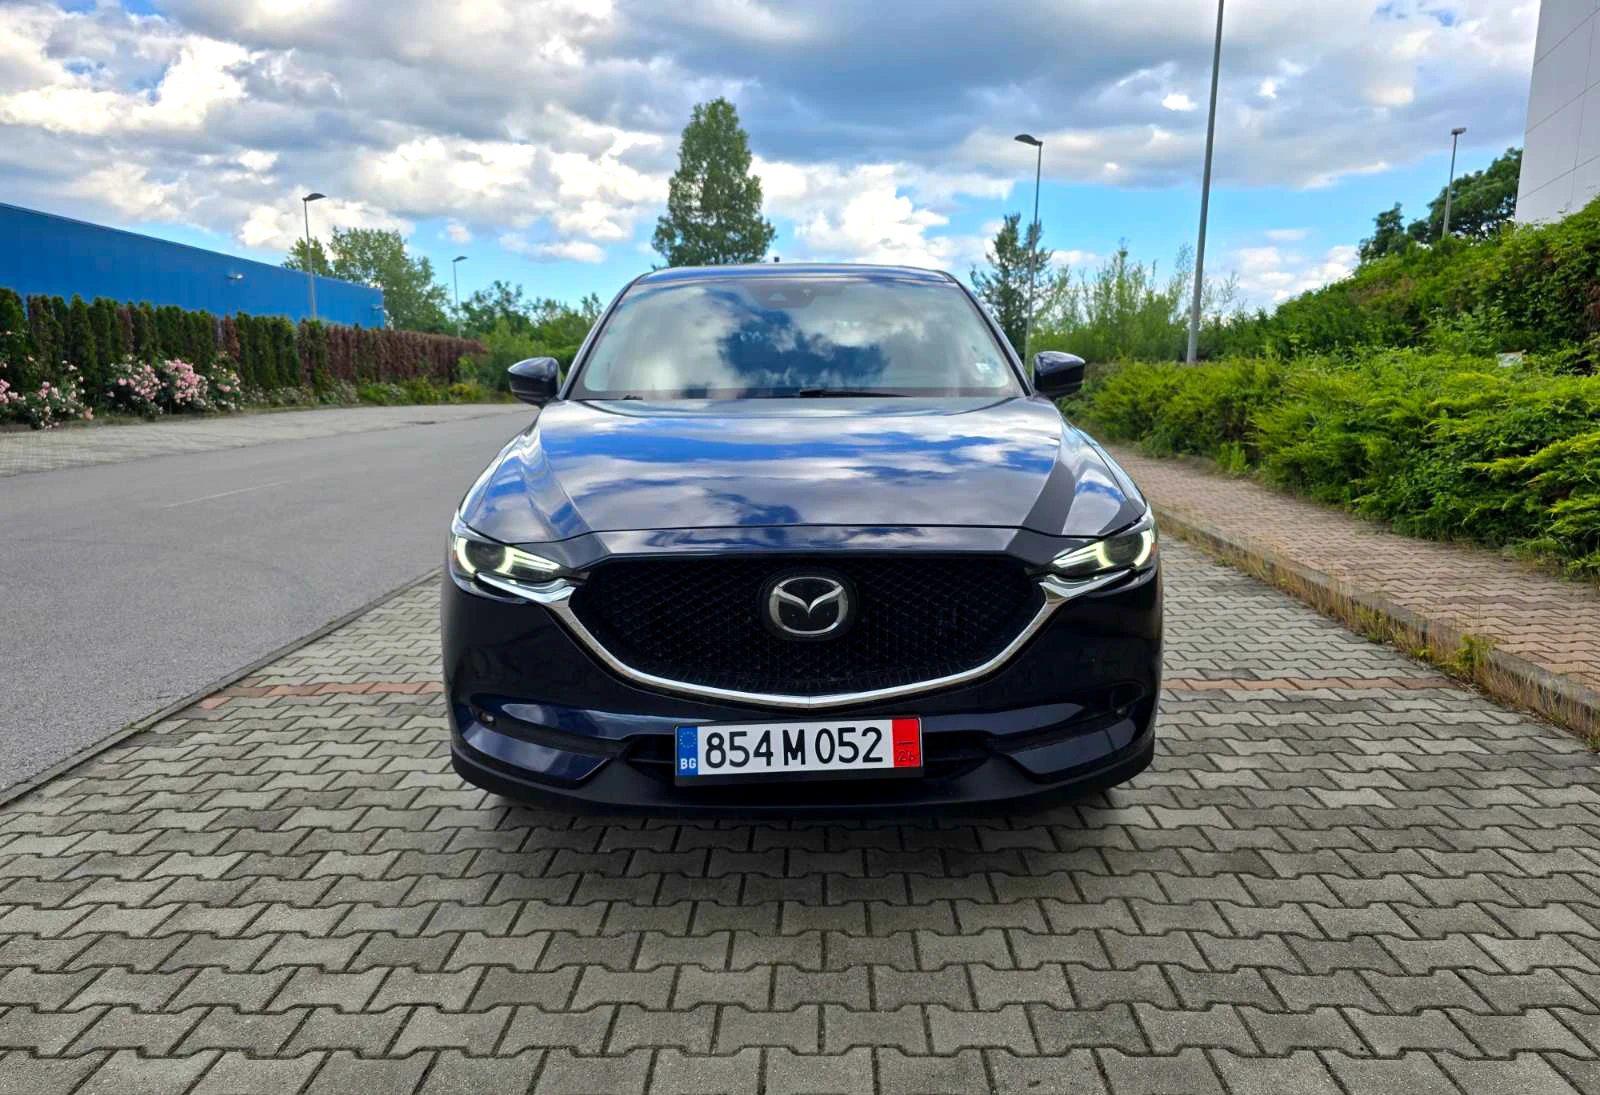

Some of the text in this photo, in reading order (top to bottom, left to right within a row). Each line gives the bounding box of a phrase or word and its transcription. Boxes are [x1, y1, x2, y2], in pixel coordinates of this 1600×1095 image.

[705, 726, 884, 769] 854 M 052
[680, 757, 697, 770] BG
